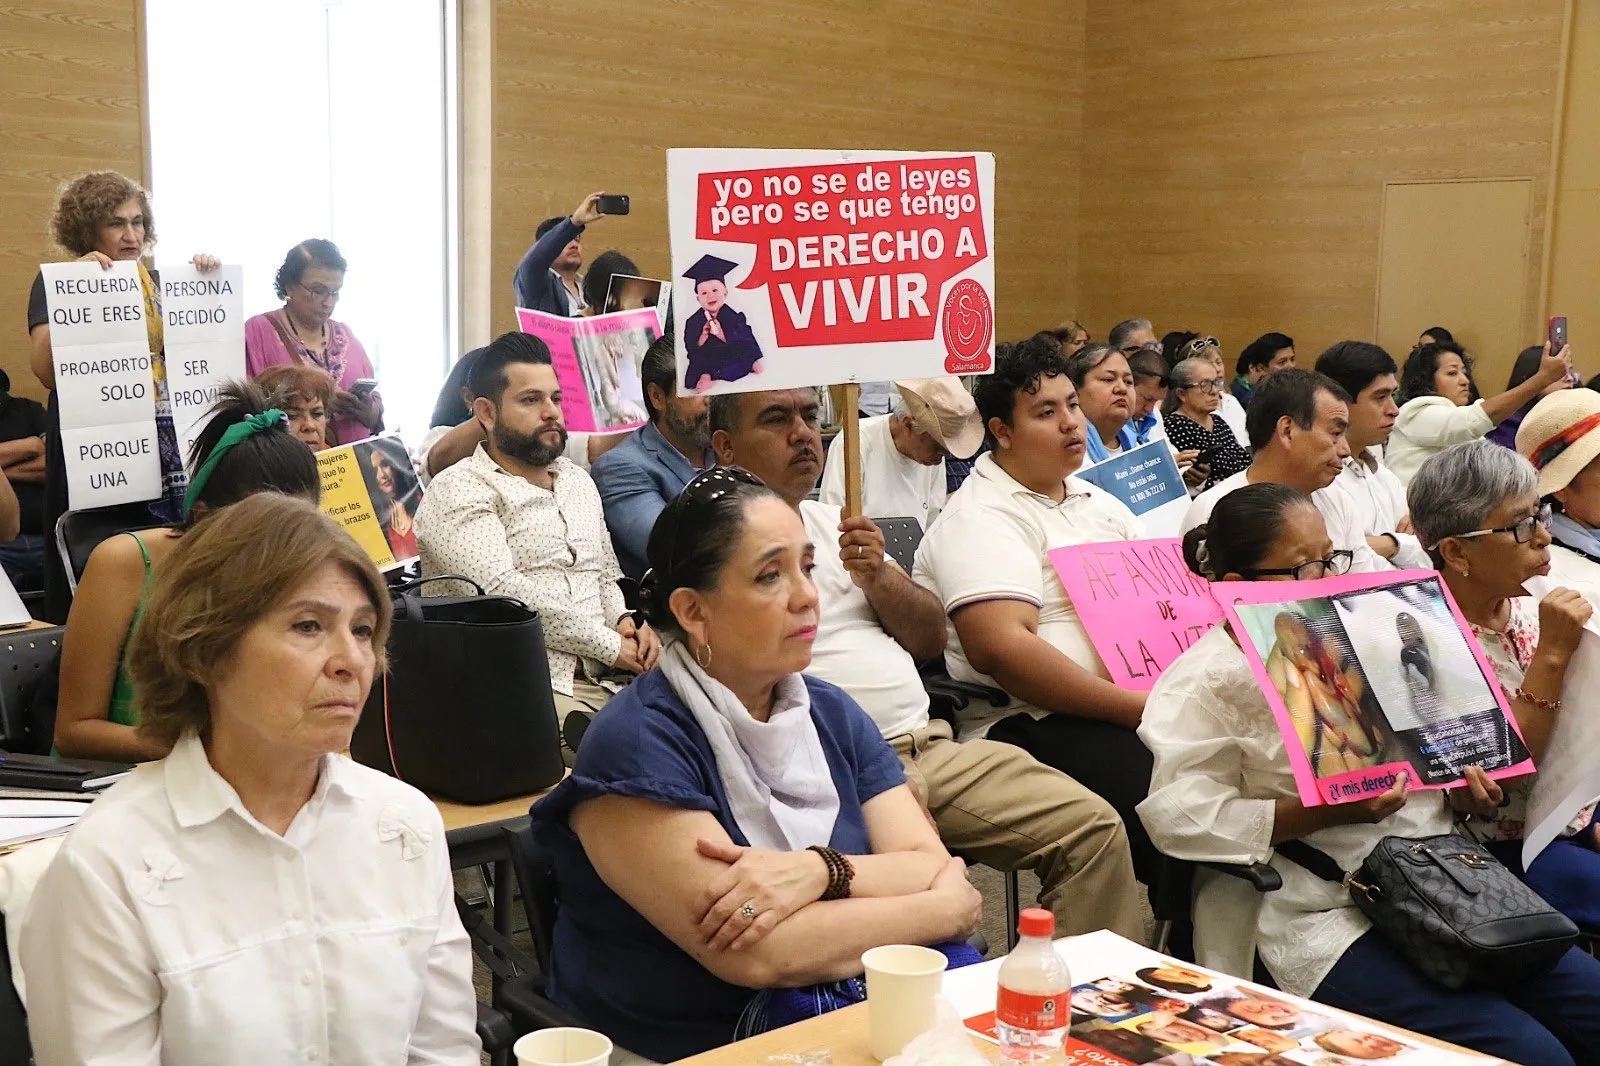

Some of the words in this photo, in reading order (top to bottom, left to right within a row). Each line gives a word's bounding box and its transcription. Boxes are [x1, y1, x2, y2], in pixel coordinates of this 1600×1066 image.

[713, 177, 752, 205] yo
[763, 175, 802, 196] no
[812, 173, 847, 195] se
[857, 166, 891, 192] de
[900, 164, 972, 196] leyes
[711, 203, 783, 233] pero
[794, 200, 830, 222] se
[839, 197, 892, 225] que
[902, 191, 976, 220] tengo
[770, 228, 945, 271] DERECHO
[954, 226, 978, 258] A
[55, 278, 139, 295] RECUERDA
[165, 280, 233, 297] PERSONA
[946, 287, 960, 308] Voces
[960, 283, 972, 293] por
[973, 283, 978, 293] la
[978, 289, 988, 308] Vida
[778, 272, 931, 330] VIVIR
[53, 307, 92, 325] QUE
[102, 306, 141, 323] ERES
[168, 305, 226, 326] DECIDIÓ
[60, 357, 149, 377] PROABORTO
[184, 360, 209, 376] SER
[952, 362, 984, 371] Salamanca
[100, 384, 145, 402] SOLO
[174, 388, 221, 407] PROVI
[80, 438, 151, 461] PORQUE
[1144, 457, 1161, 467] chance
[90, 471, 128, 490] UNA
[321, 469, 337, 480] que
[338, 467, 346, 476] lo
[348, 501, 361, 511] los
[344, 513, 371, 525] brazos
[1156, 600, 1177, 620] DE
[1116, 640, 1162, 678] LA
[1342, 779, 1360, 796] mis
[1361, 768, 1413, 792] derech?
